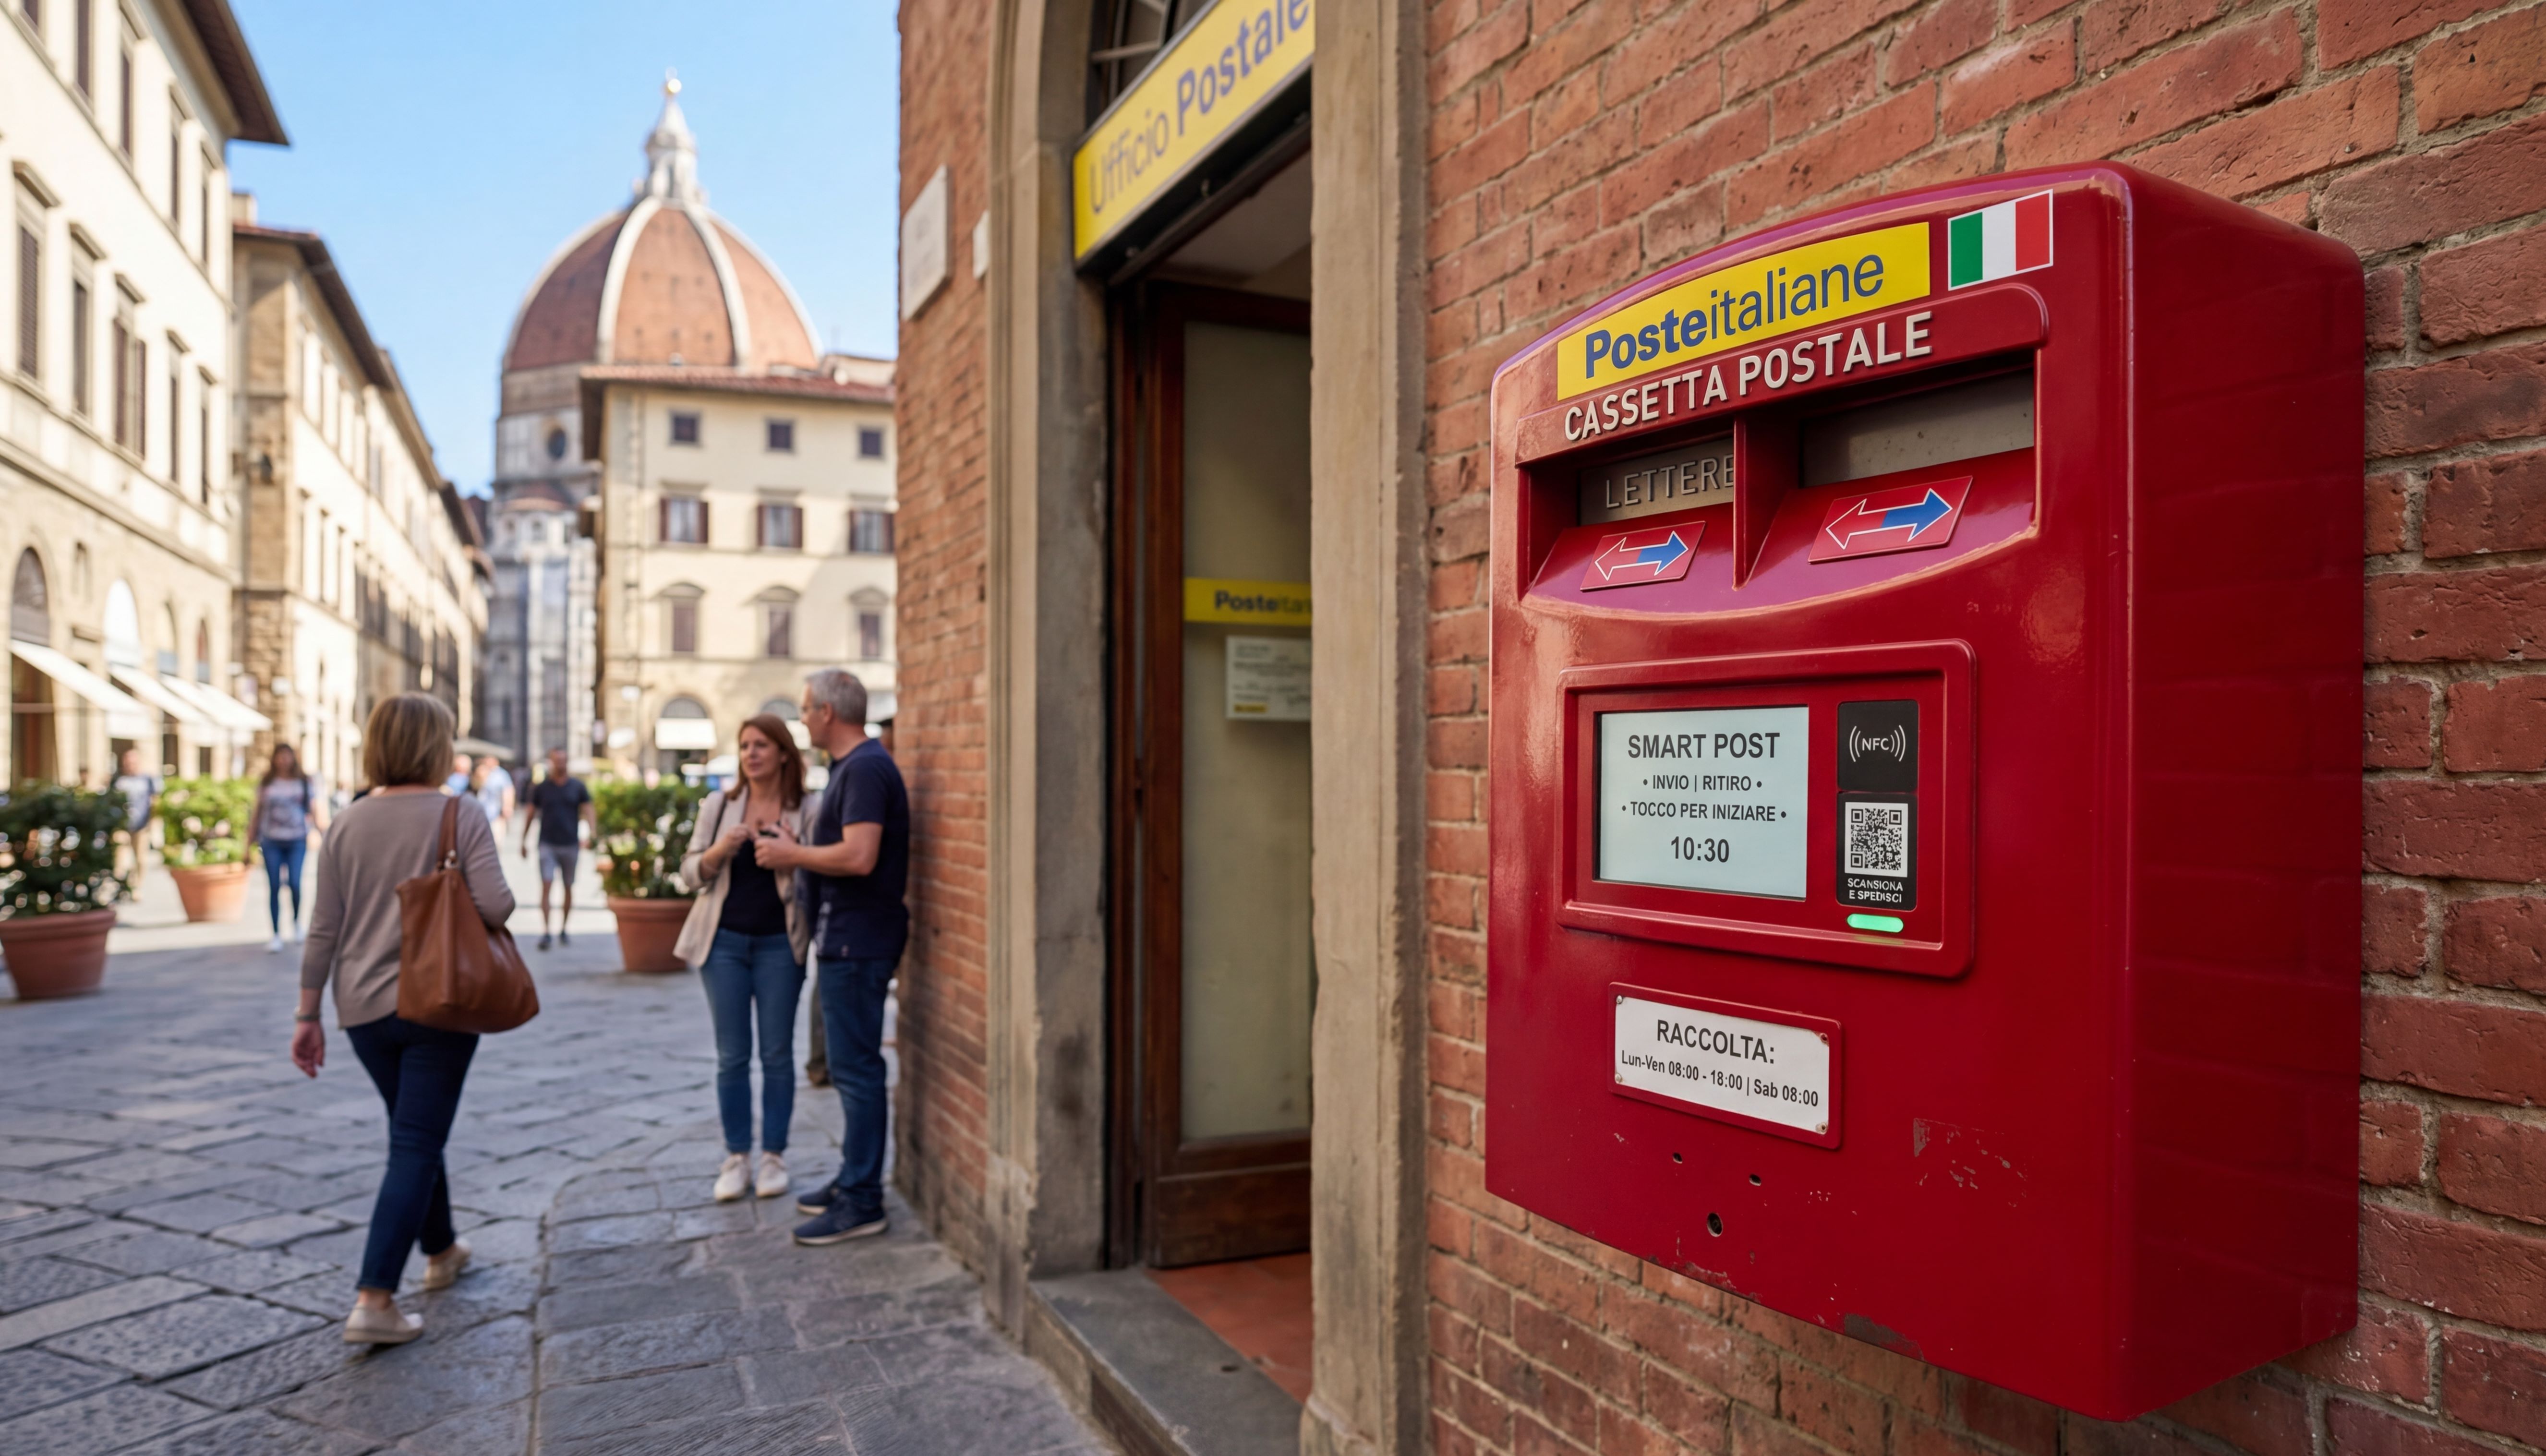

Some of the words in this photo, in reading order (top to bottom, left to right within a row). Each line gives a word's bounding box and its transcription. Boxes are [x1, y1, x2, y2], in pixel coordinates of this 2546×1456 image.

[1090, 109, 1169, 213] Ufficio
[1585, 254, 1884, 379] Posteitaliane
[1564, 365, 1728, 441] CASSETTA
[1739, 311, 1933, 396] POSTALE
[1606, 454, 1734, 508] LETTERE
[1628, 734, 1706, 758] SMART
[1714, 733, 1780, 758] POST
[1862, 738, 1889, 750] NFC
[1653, 775, 1689, 790] INVIO
[1703, 776, 1751, 791] RITIRO
[1630, 801, 1676, 817] TOCCO
[1680, 803, 1708, 818] PER
[1713, 805, 1775, 821] INIZIARE
[1671, 836, 1729, 863] 10:30
[1847, 878, 1903, 891] SCANSIONA
[1849, 890, 1856, 899] E
[1858, 890, 1902, 902] SPEDISCI
[1657, 1019, 1774, 1064] RACCOLTA:
[1622, 1050, 1665, 1073] Lun-Ven
[1668, 1060, 1699, 1081] 08:00
[1710, 1070, 1742, 1090] 18:00
[1754, 1079, 1778, 1098] Sab
[1783, 1085, 1818, 1107] 08:00
